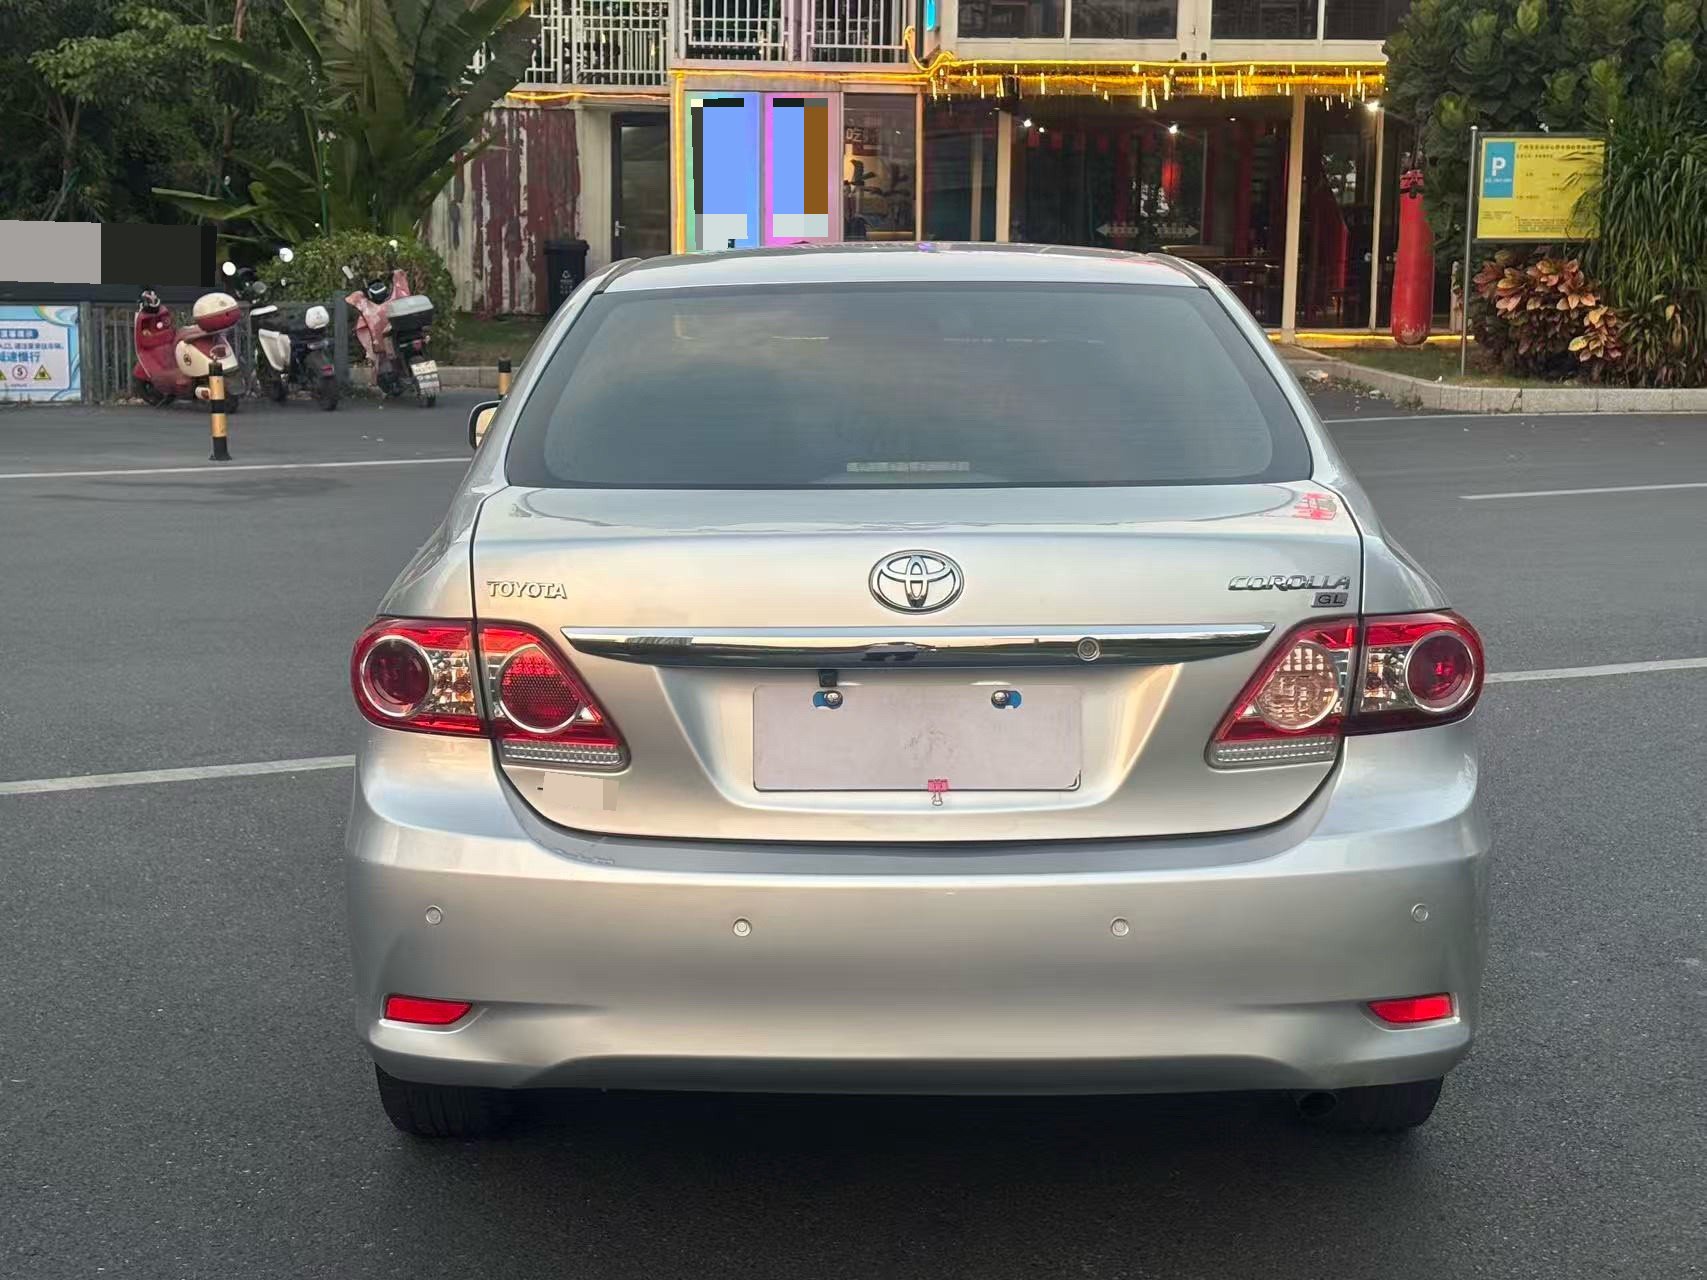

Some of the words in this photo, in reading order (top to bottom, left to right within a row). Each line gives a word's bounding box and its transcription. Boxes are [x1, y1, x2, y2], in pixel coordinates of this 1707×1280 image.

[1491, 156, 1506, 177] P
[17, 367, 23, 377] 5
[486, 580, 568, 600] TOYOTA
[1228, 575, 1351, 591] COROLLA
[1316, 593, 1345, 606] GL
